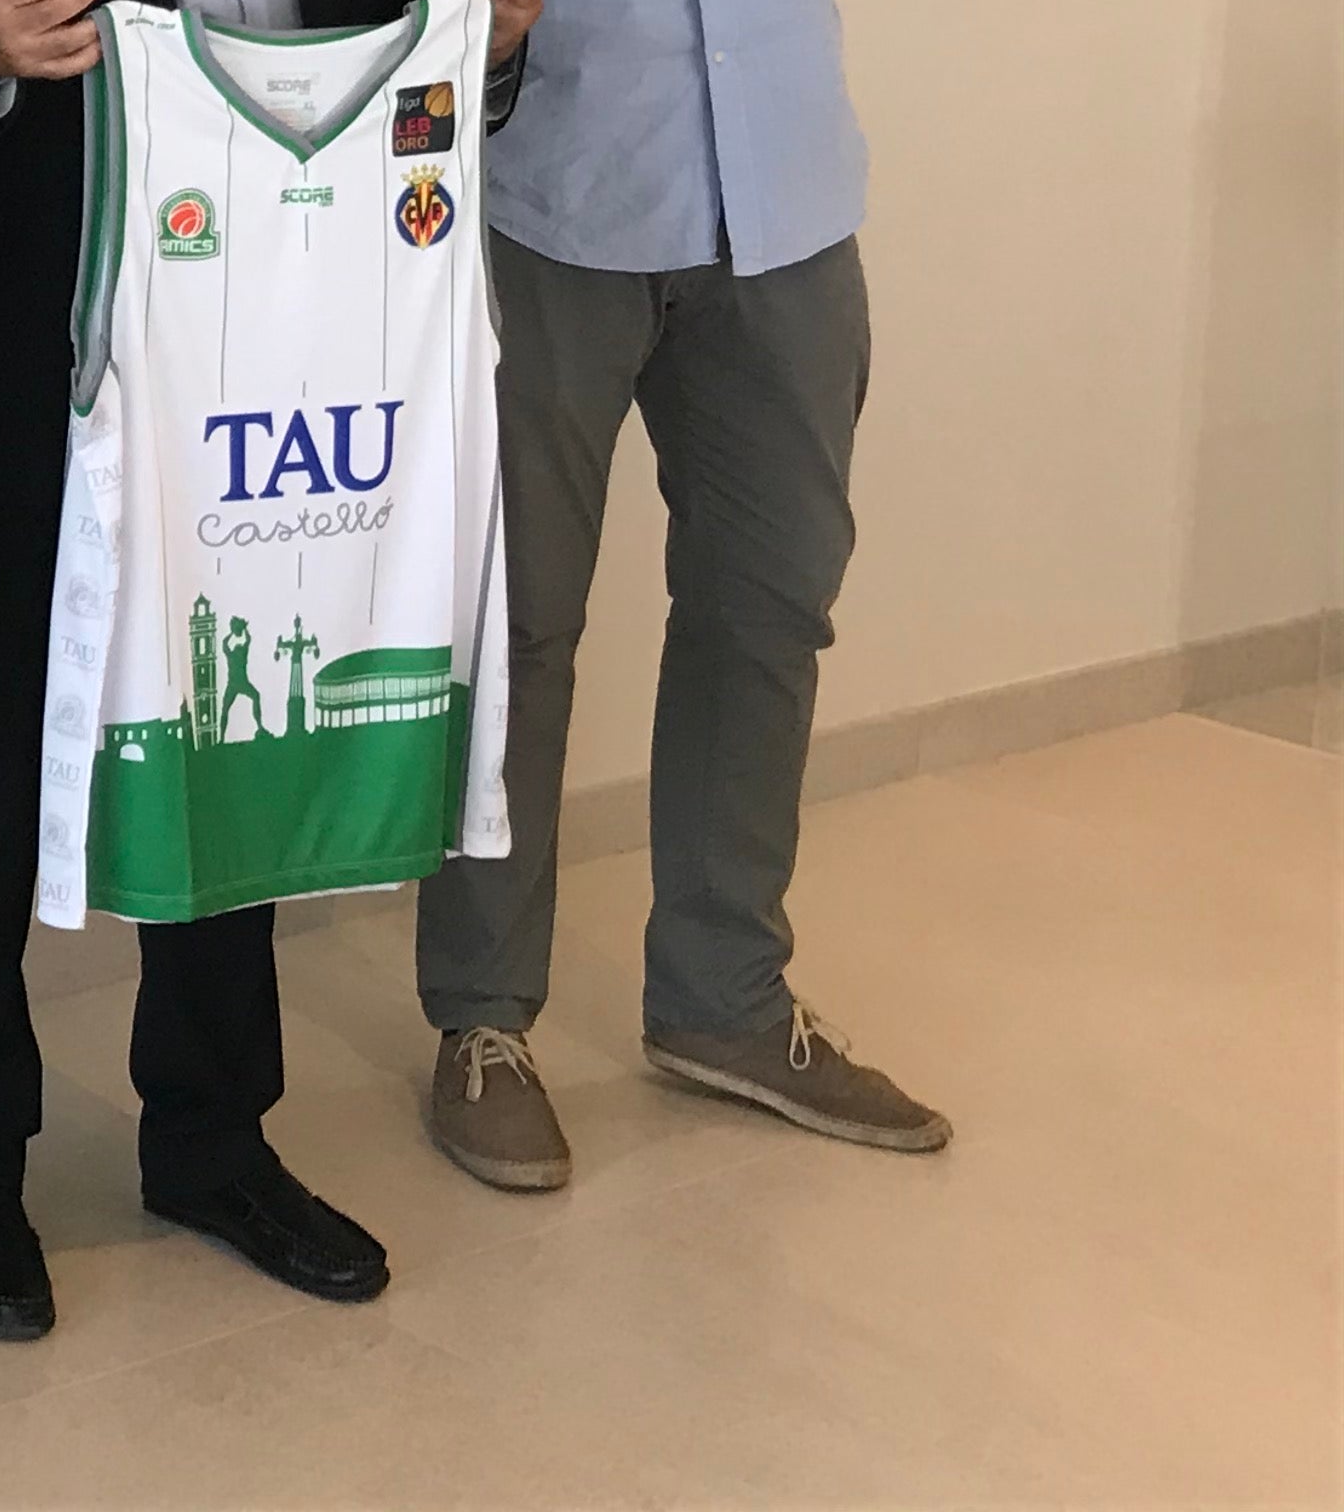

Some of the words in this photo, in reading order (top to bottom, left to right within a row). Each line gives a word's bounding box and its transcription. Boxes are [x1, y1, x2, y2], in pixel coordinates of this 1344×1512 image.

[394, 115, 432, 136] LEB
[394, 136, 430, 152] ORO
[279, 186, 334, 204] SCORE
[159, 239, 215, 253] AMICS
[204, 400, 405, 502] TAU
[197, 496, 396, 548] Castelló
